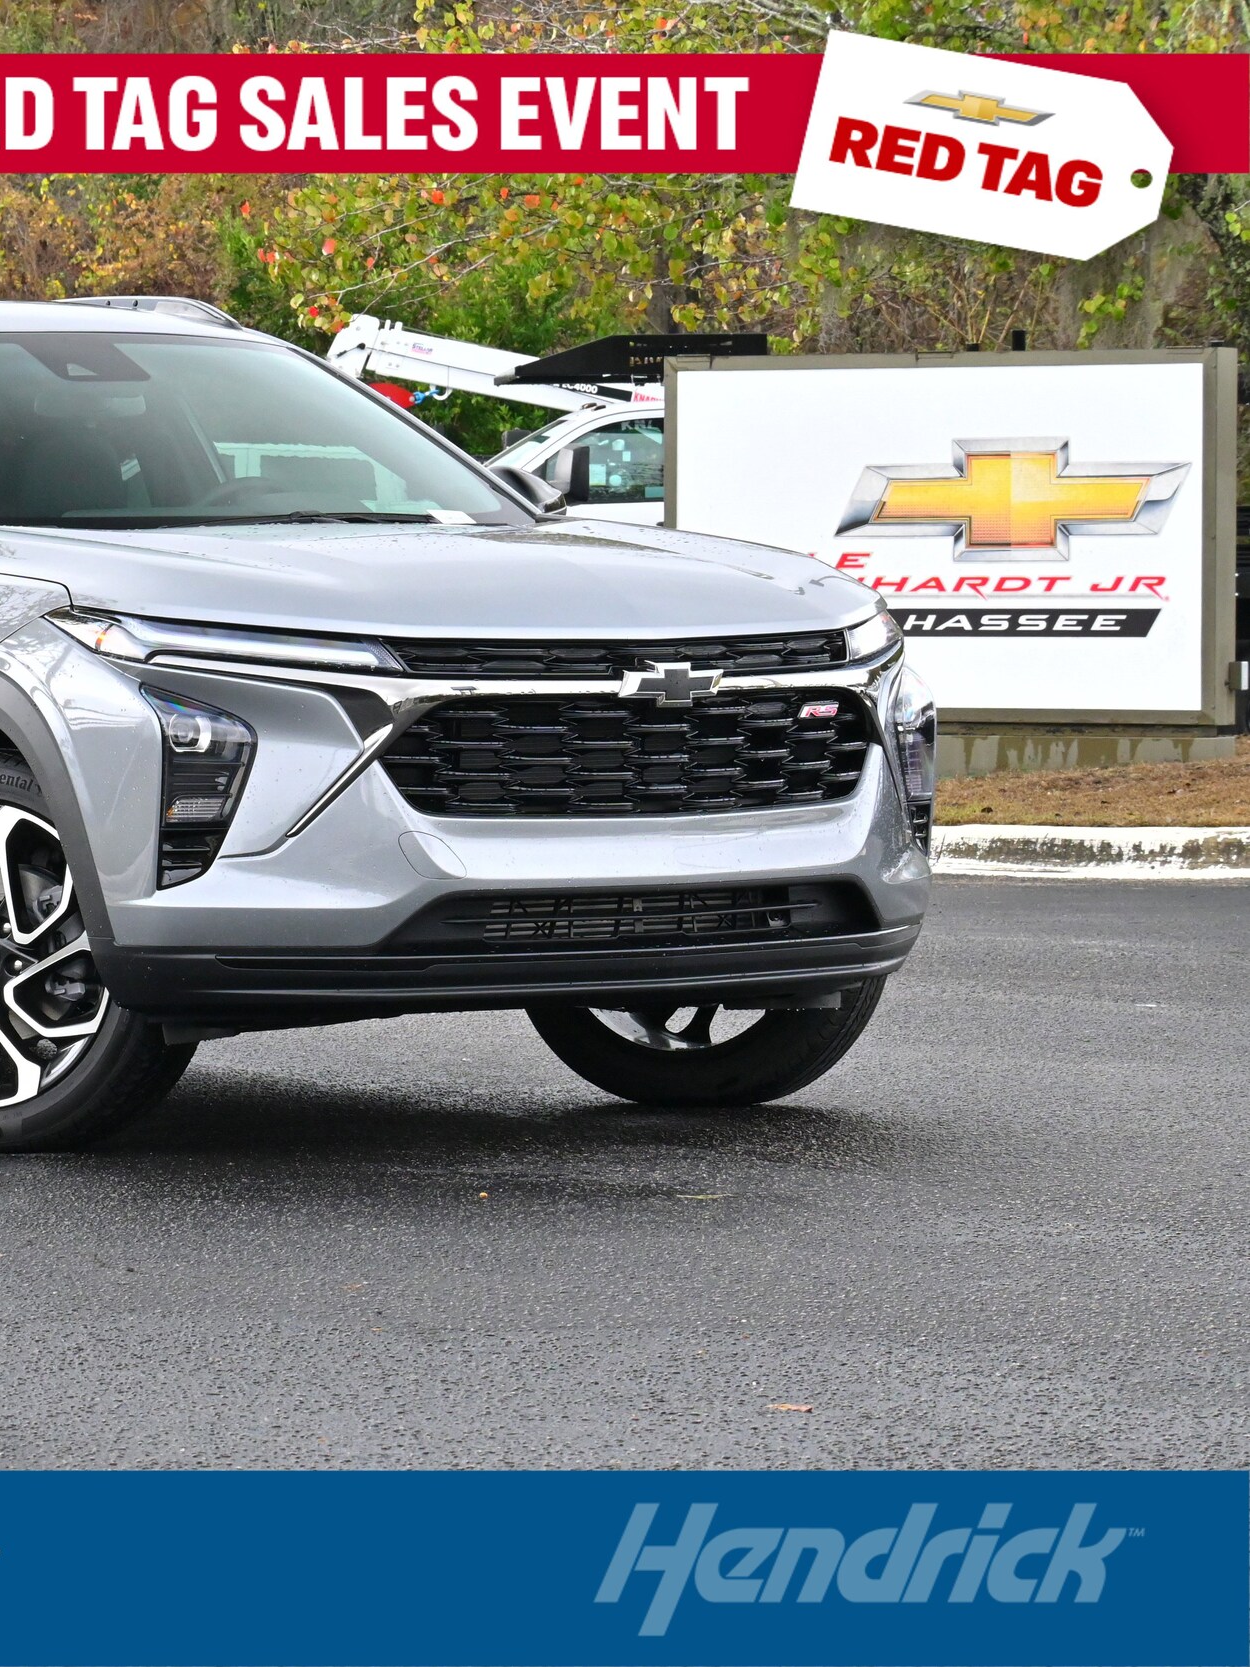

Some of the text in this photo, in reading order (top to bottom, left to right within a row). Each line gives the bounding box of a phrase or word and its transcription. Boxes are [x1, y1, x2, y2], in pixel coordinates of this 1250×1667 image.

[857, 576, 1167, 600] HARDT JR
[903, 614, 1128, 631] HASSEE
[804, 703, 838, 718] RS
